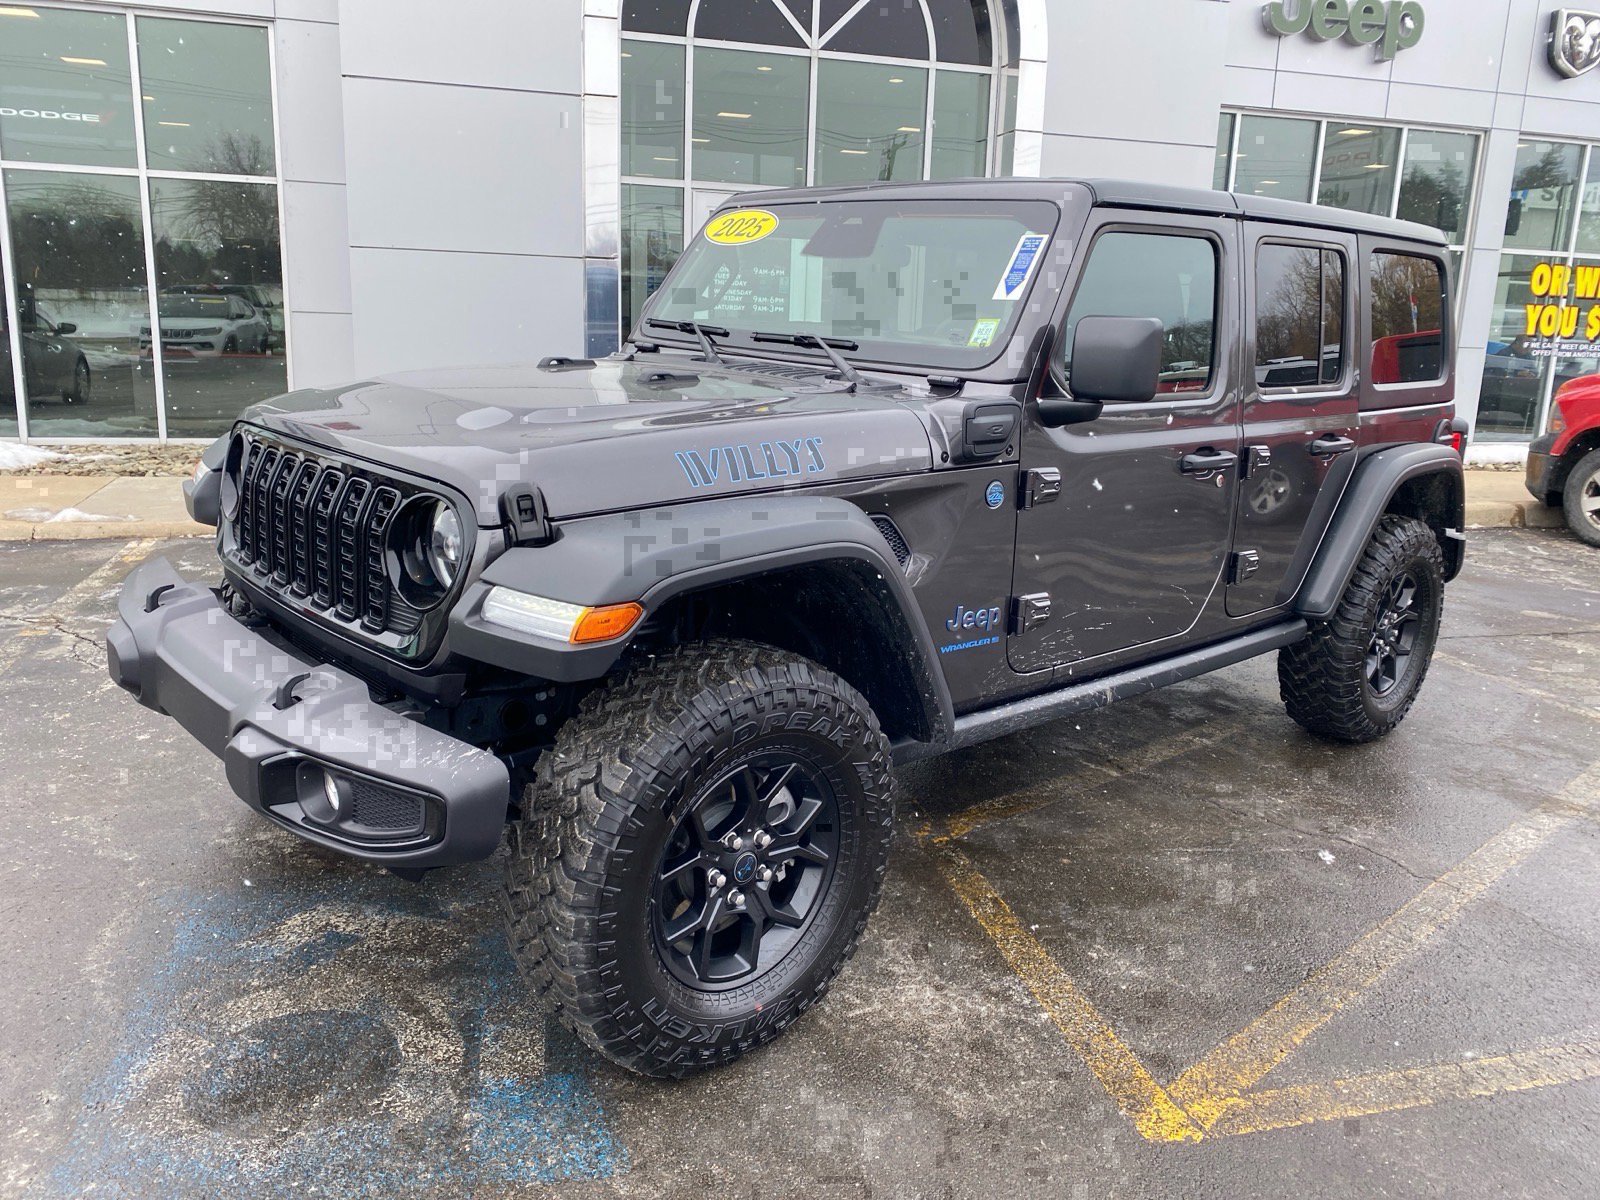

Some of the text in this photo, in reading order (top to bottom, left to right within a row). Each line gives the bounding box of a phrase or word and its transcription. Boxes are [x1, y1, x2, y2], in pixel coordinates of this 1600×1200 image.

[1262, 0, 1425, 62] Jeep
[0, 107, 100, 122] DODGE
[711, 217, 771, 238] 2025
[1531, 263, 1571, 297] OR
[1525, 304, 1579, 338] YOU
[675, 437, 826, 487] WILLYS
[946, 605, 1001, 631] Jeep
[940, 638, 990, 654] WRANGLER
